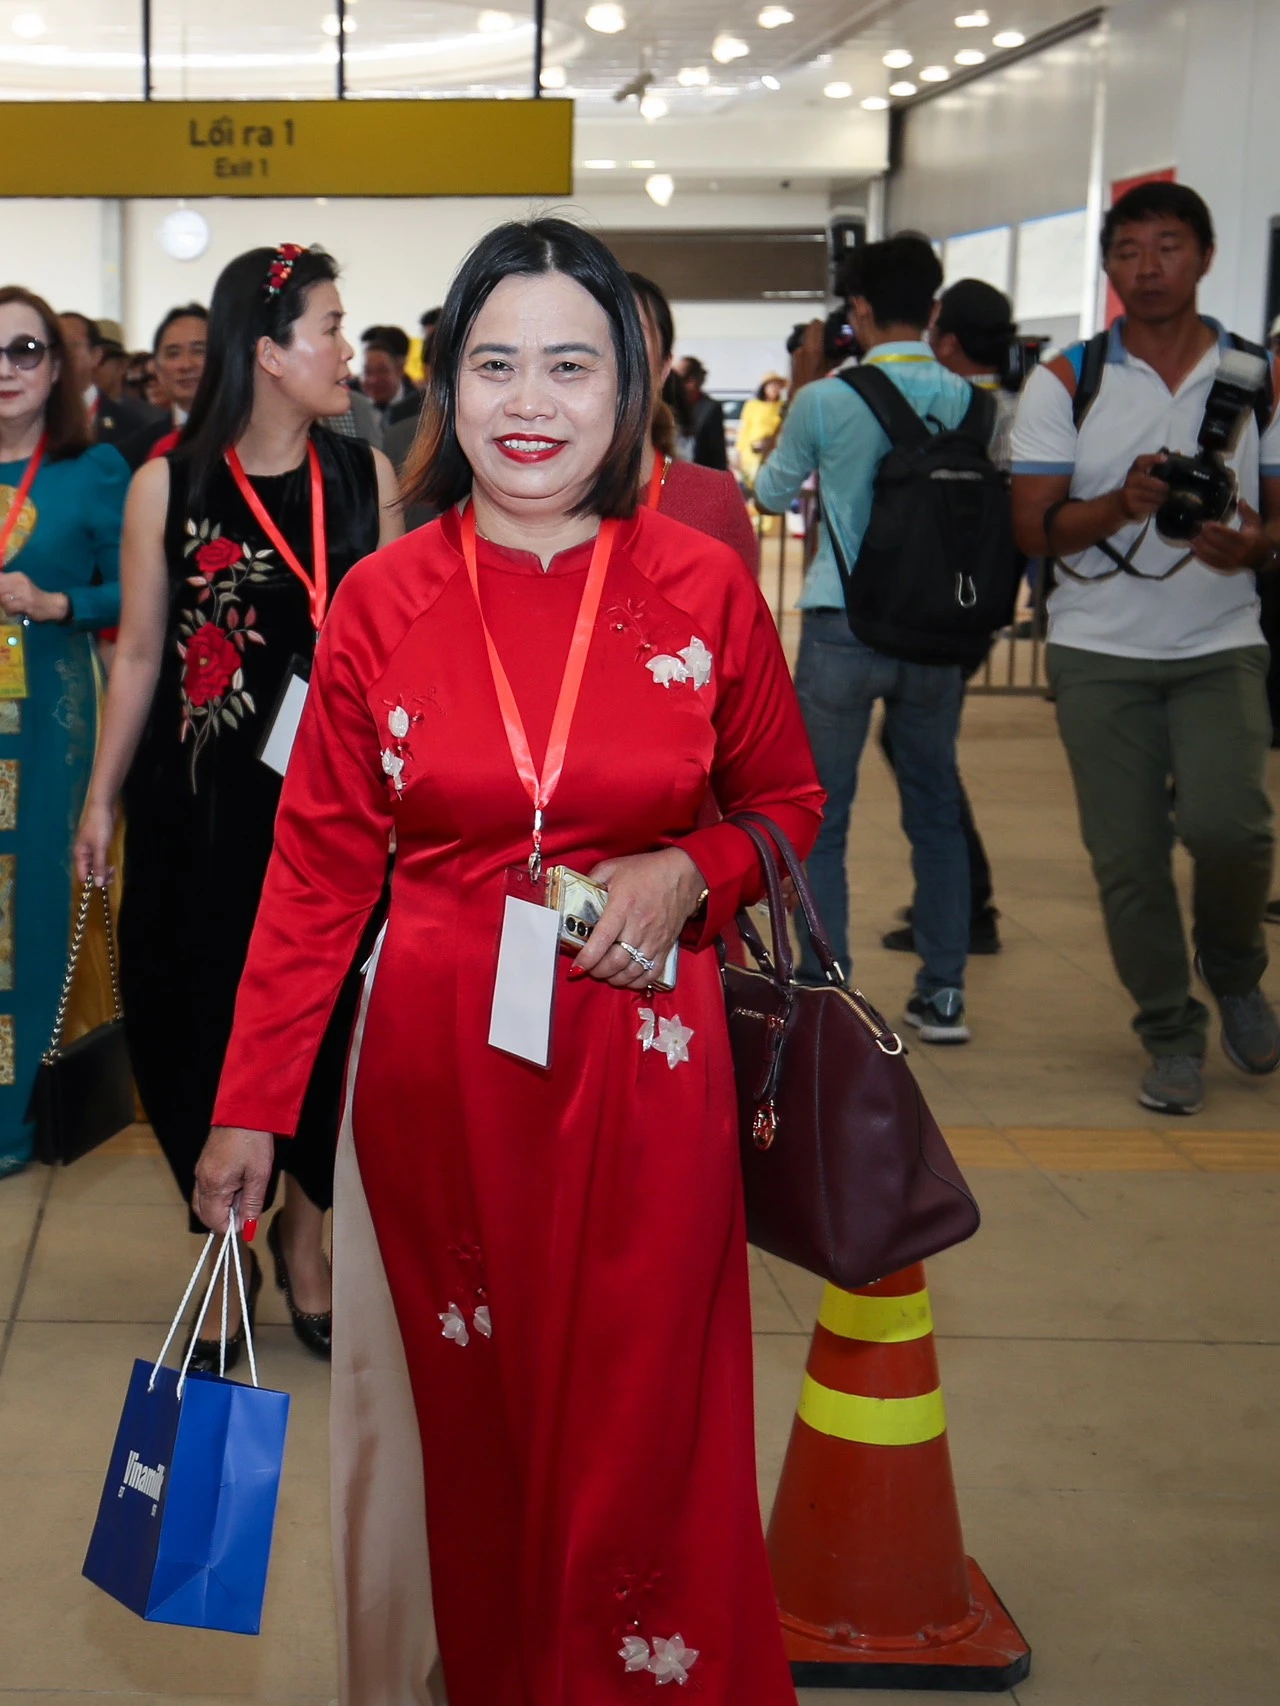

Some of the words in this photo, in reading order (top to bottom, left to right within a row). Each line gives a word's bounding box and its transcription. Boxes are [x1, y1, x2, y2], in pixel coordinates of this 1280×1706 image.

[243, 125, 274, 147] ra
[283, 118, 295, 146] 1
[215, 157, 253, 178] Exit
[260, 157, 268, 177] 1
